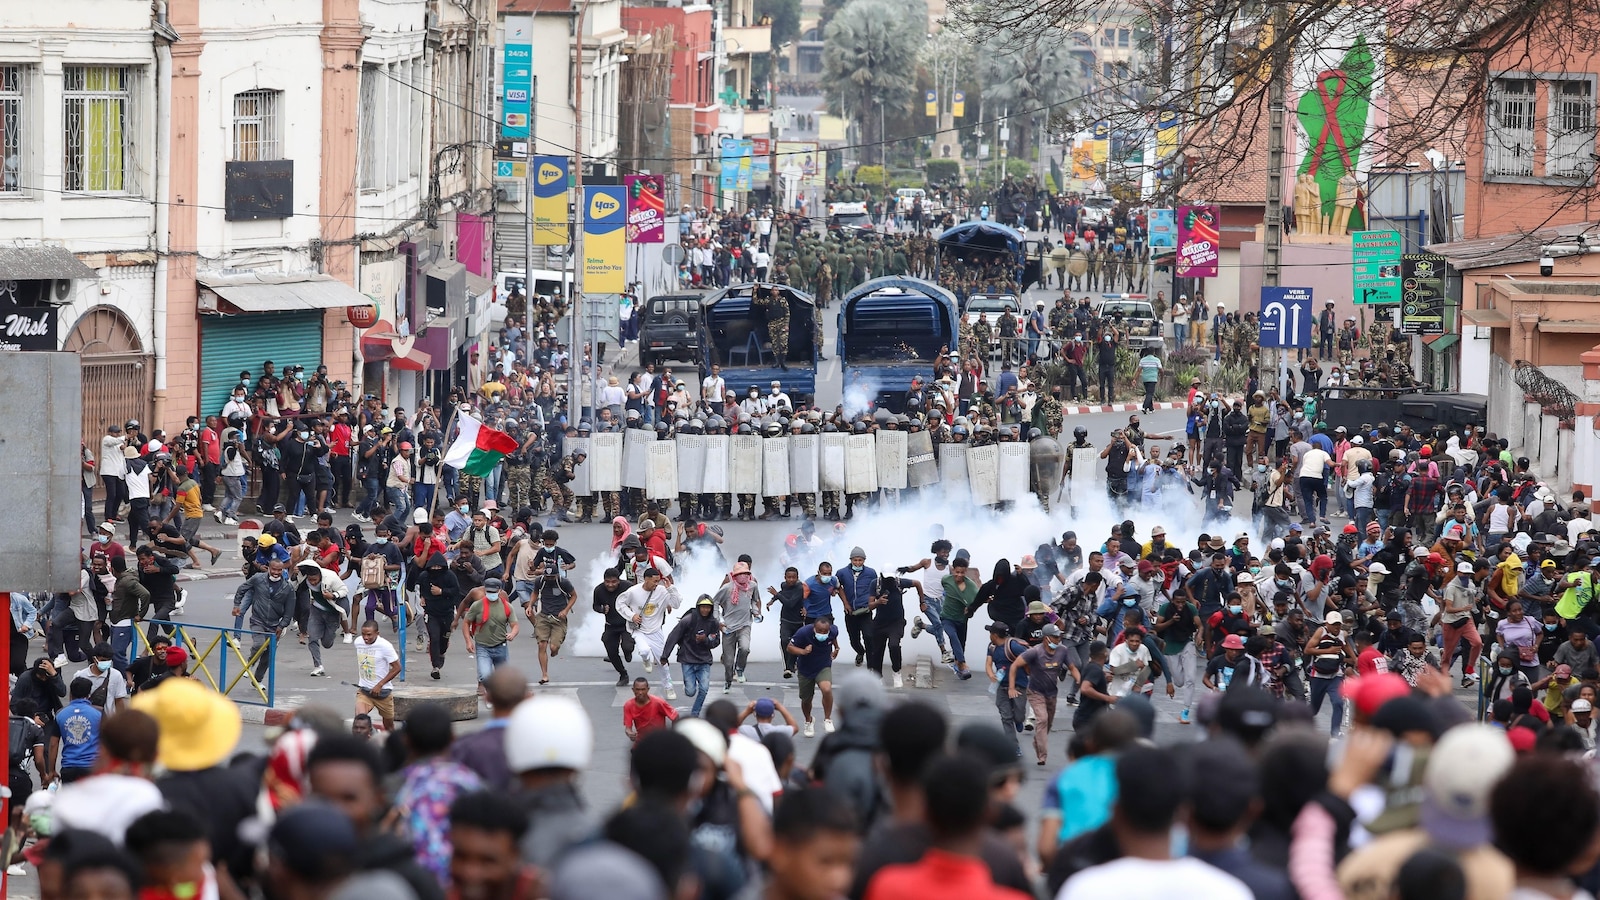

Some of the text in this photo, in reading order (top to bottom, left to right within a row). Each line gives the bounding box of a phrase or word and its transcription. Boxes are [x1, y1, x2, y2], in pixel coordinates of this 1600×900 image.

[508, 50, 529, 58] 24/24
[508, 91, 527, 99] VISA
[542, 170, 559, 179] yas
[595, 201, 615, 213] yas
[351, 309, 369, 319] THB
[77, 715, 92, 727] MOLY
